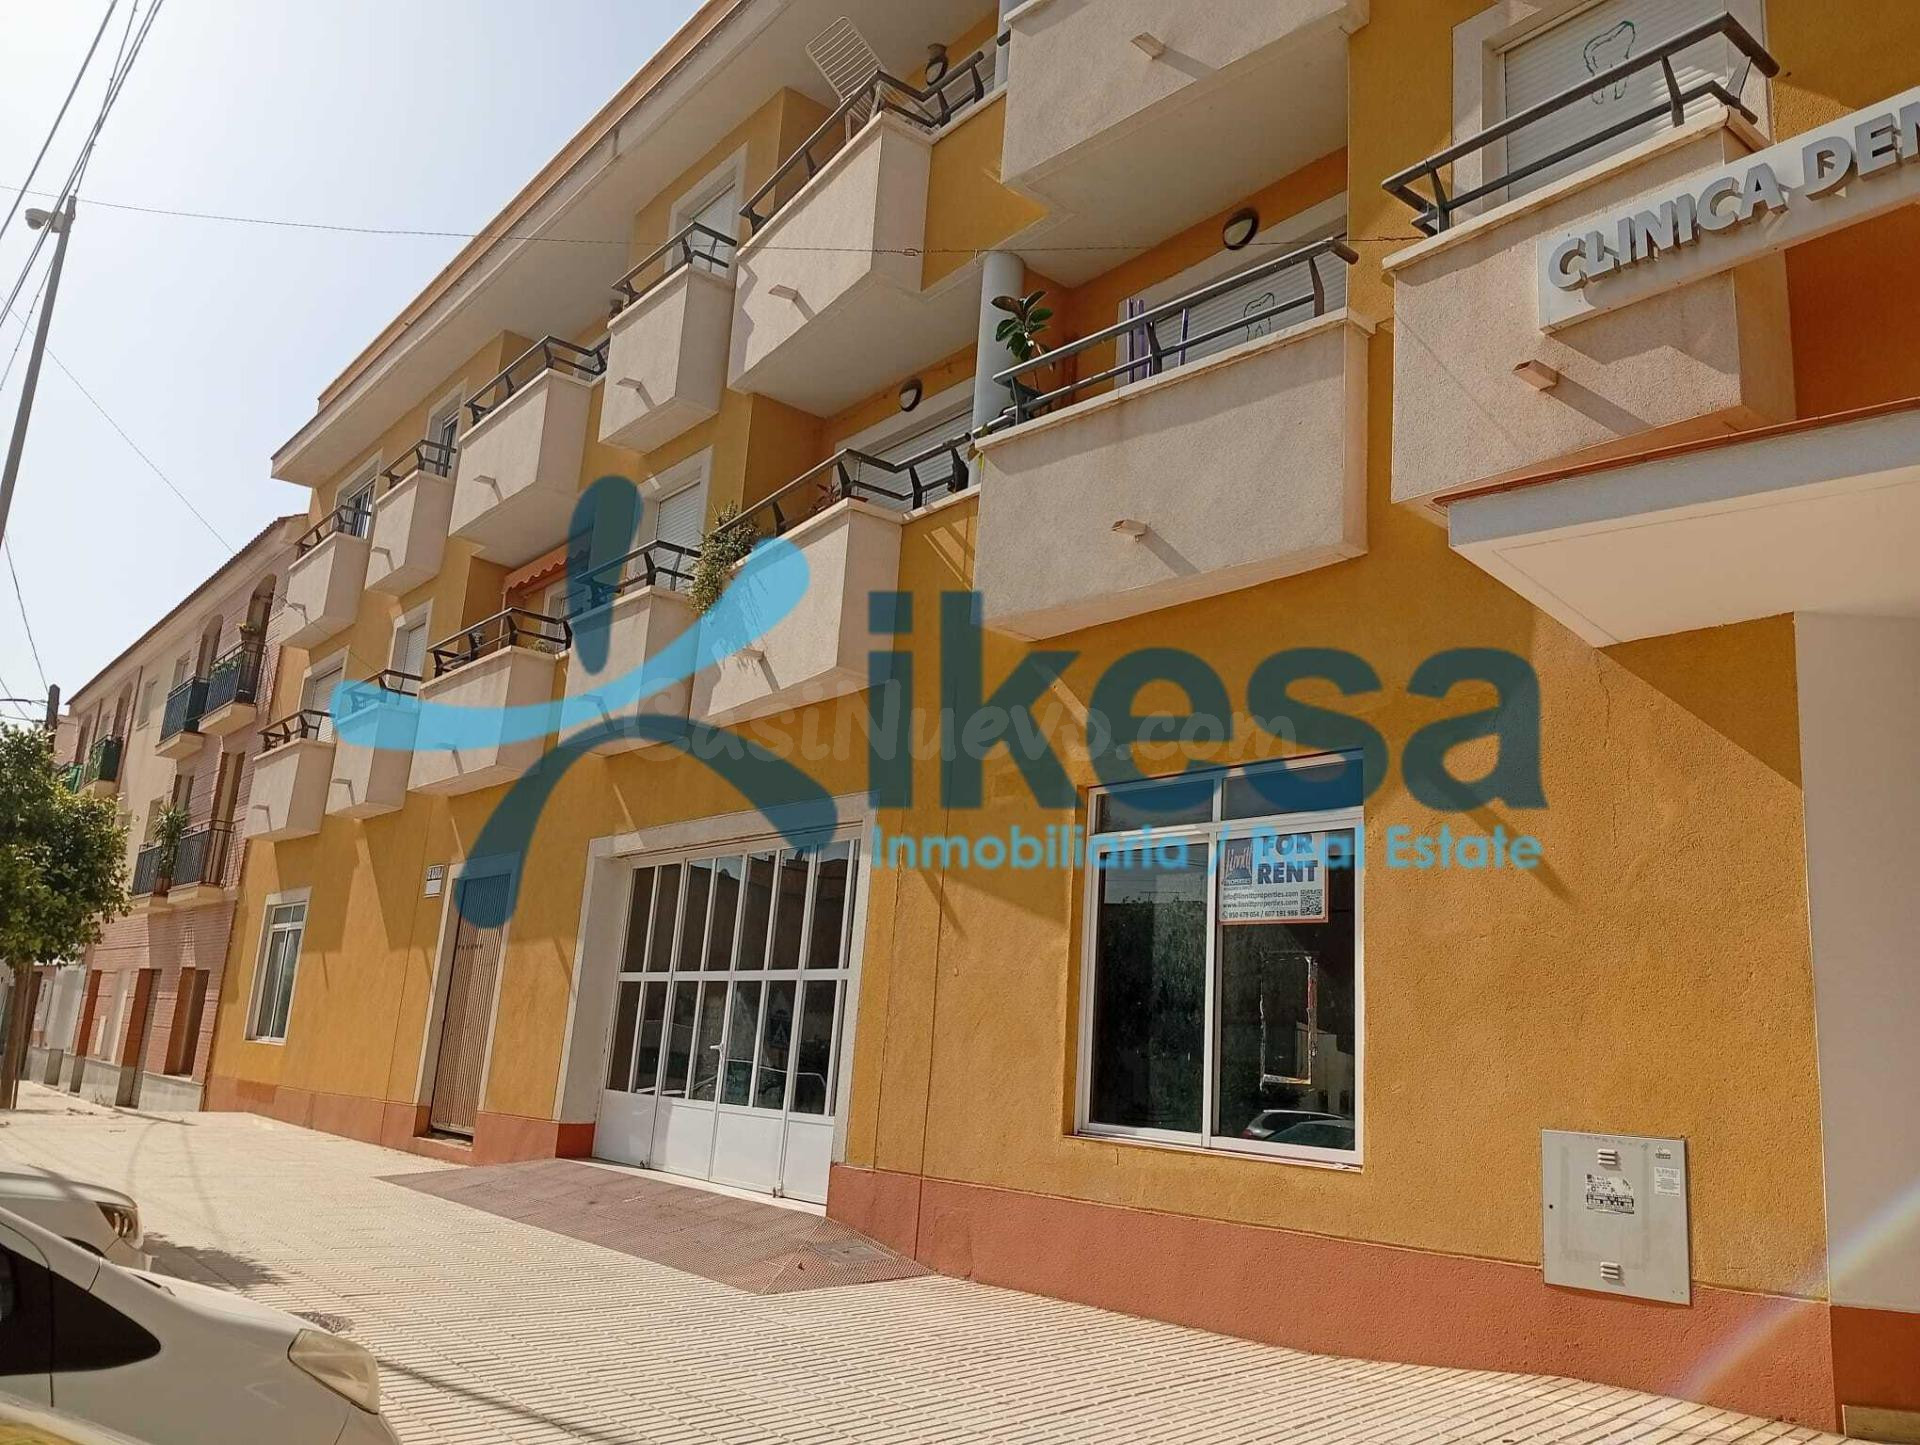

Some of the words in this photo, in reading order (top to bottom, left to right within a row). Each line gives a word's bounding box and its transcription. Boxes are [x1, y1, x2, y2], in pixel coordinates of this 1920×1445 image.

[1548, 163, 1785, 290] CLINICA
[1262, 833, 1314, 856] FOR
[1257, 860, 1318, 885] RENT
